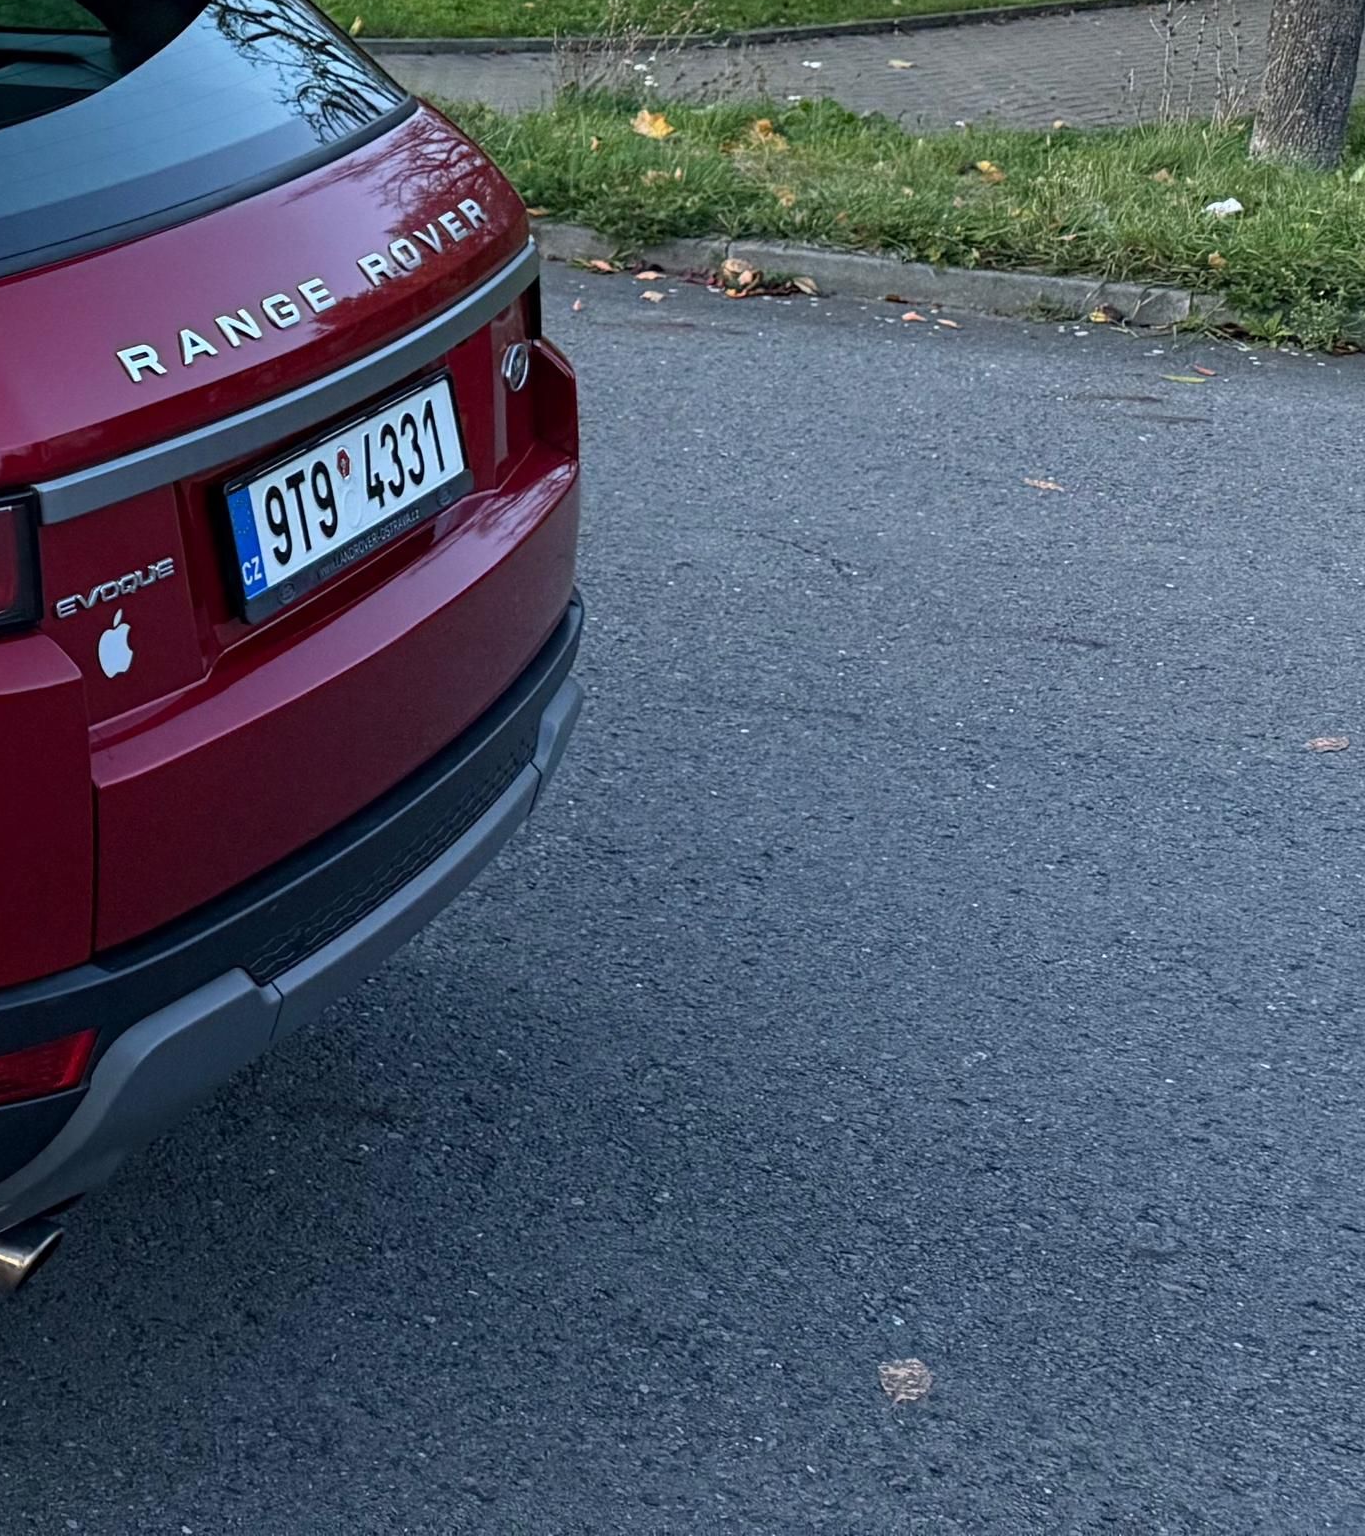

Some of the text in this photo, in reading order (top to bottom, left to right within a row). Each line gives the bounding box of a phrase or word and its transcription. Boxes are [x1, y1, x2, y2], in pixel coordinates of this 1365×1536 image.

[117, 198, 488, 382] RANGE ROVER
[265, 399, 444, 565] 9T9 4331
[56, 557, 175, 618] EVOQUE
[241, 556, 262, 586] CZ
